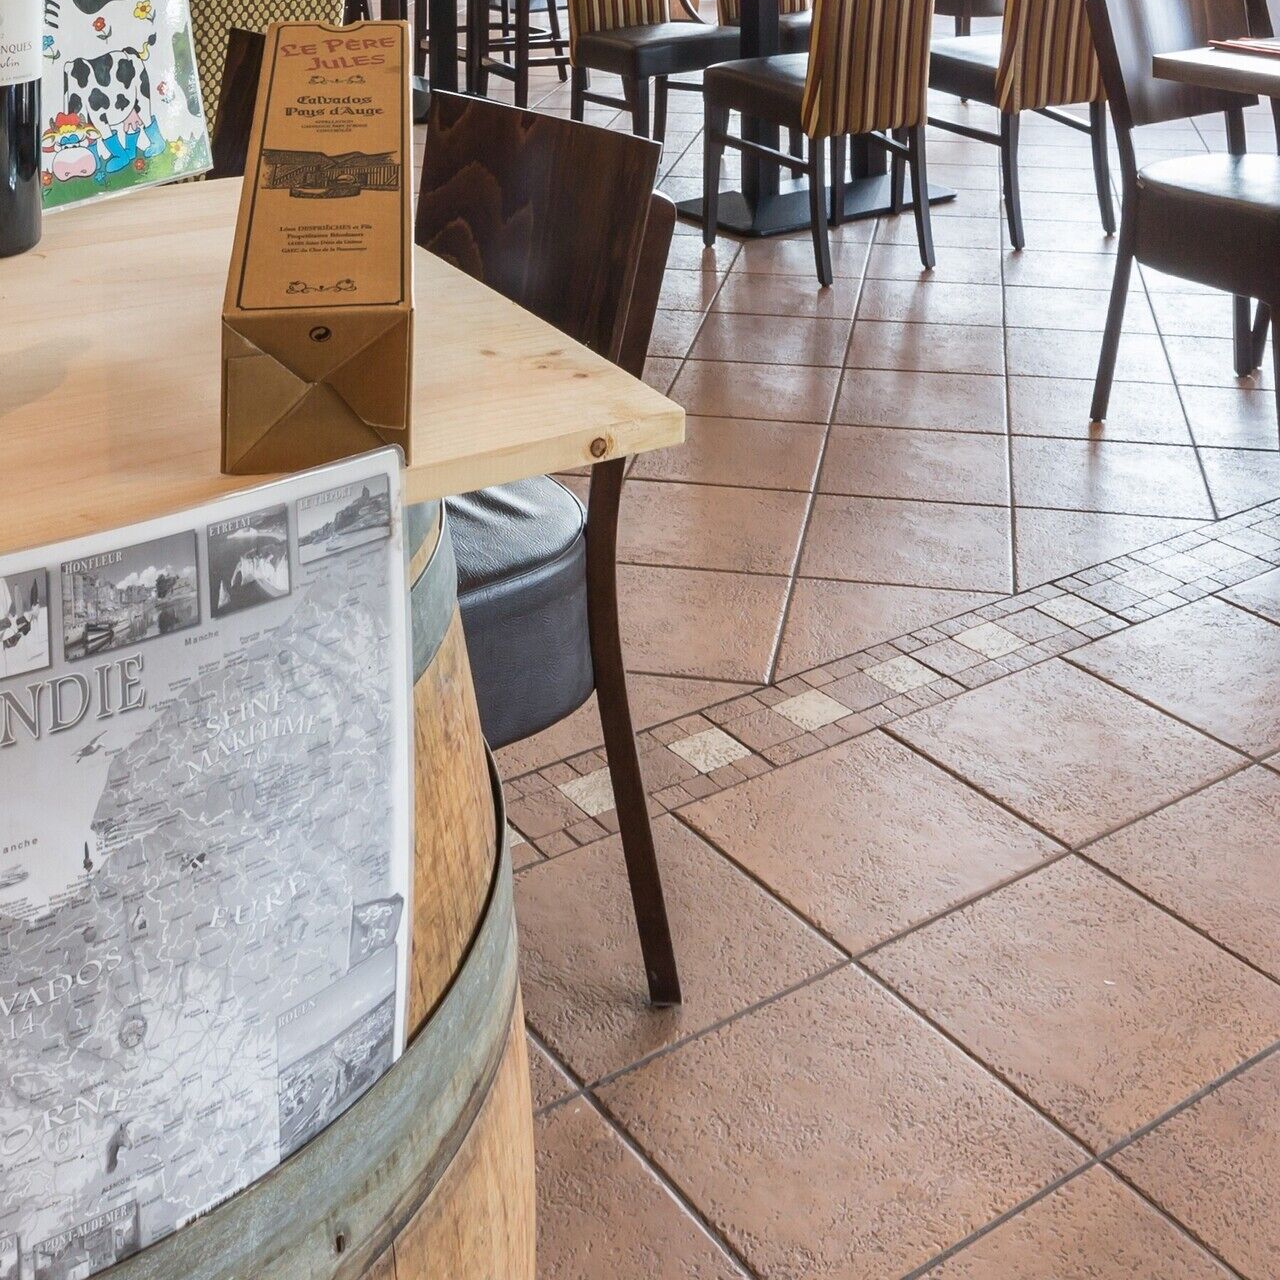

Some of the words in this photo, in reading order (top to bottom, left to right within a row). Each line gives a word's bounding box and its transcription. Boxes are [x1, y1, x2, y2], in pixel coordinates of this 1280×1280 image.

[280, 44, 318, 57] LE
[305, 54, 385, 72] JULES
[285, 106, 326, 118] Pays
[329, 106, 385, 117] d'Auge
[296, 95, 373, 106] Calvados
[208, 516, 253, 538] ETRETAT
[62, 550, 123, 576] HONFLEUR
[183, 630, 221, 647] Manche
[205, 690, 290, 740] SEINE
[186, 715, 321, 781] MARITIME
[242, 741, 272, 770] 76
[208, 869, 307, 929] EURE
[7, 1012, 37, 1041] 14
[0, 1086, 132, 1156] ORNE
[54, 1122, 82, 1155] 61
[43, 1205, 129, 1253] PONT-AUDEMER
